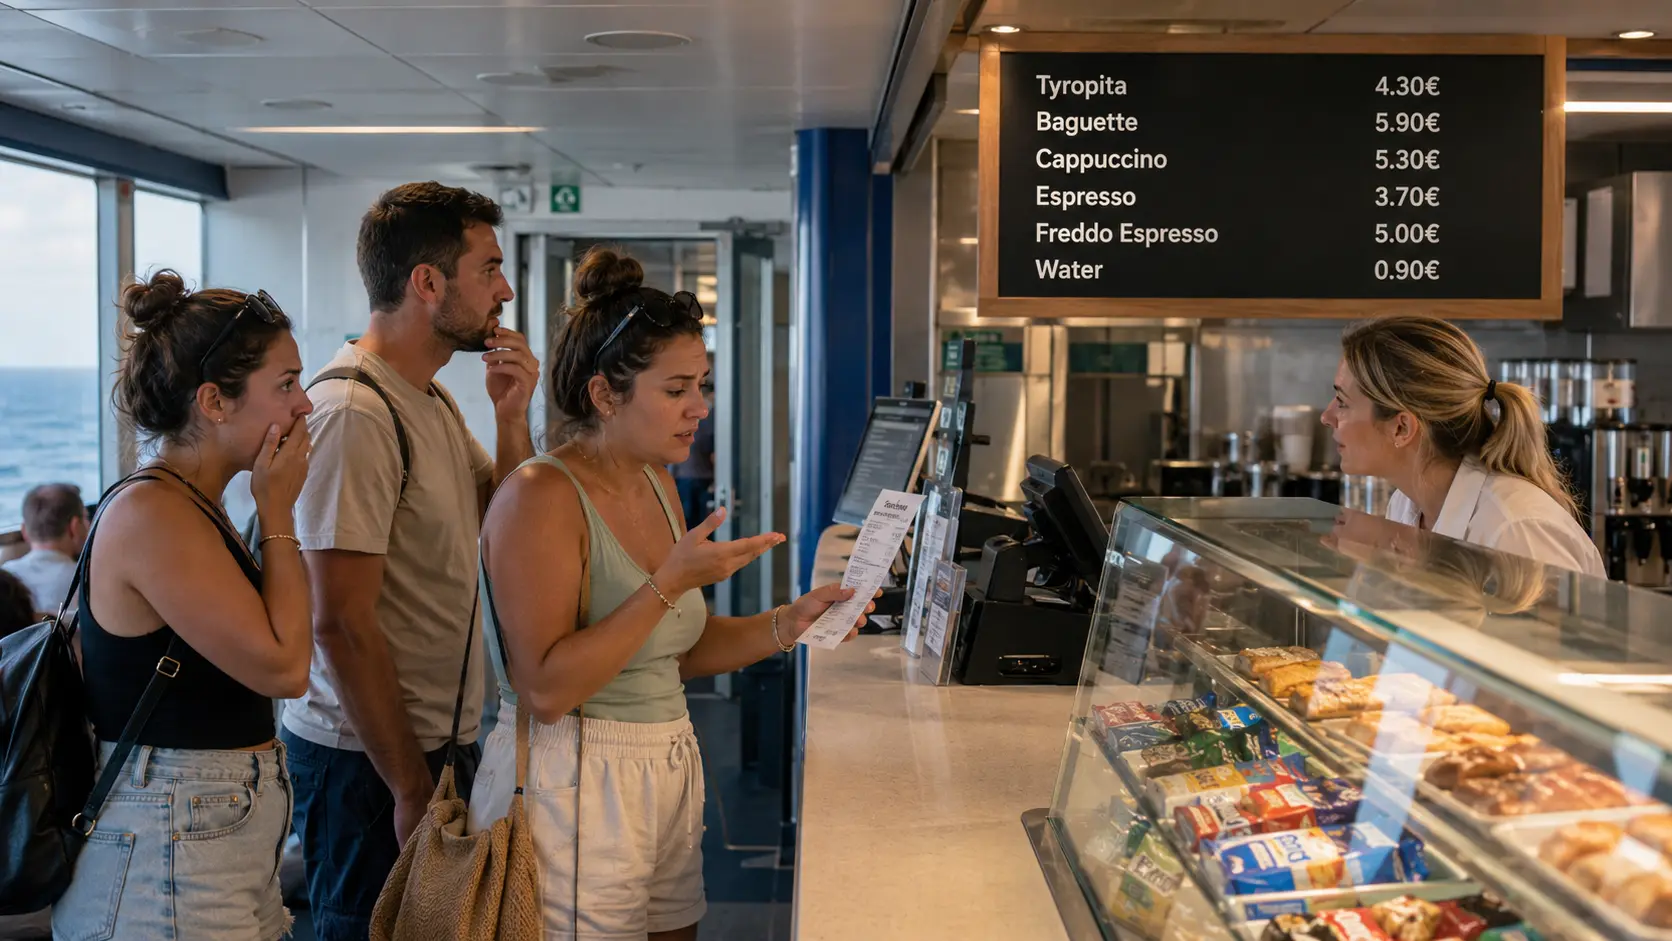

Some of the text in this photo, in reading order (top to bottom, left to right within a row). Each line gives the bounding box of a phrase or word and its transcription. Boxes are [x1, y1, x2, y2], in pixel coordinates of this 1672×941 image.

[1035, 74, 1441, 100] Tyropita 4.30€
[1036, 111, 1441, 136] Baguette 5.90€
[1035, 147, 1440, 174] Cappuccino 5.30€
[1036, 185, 1440, 211] Espresso 3.70€
[1036, 221, 1440, 248] Freddo Espresso 5.00€
[1034, 259, 1440, 281] Water 0.90€
